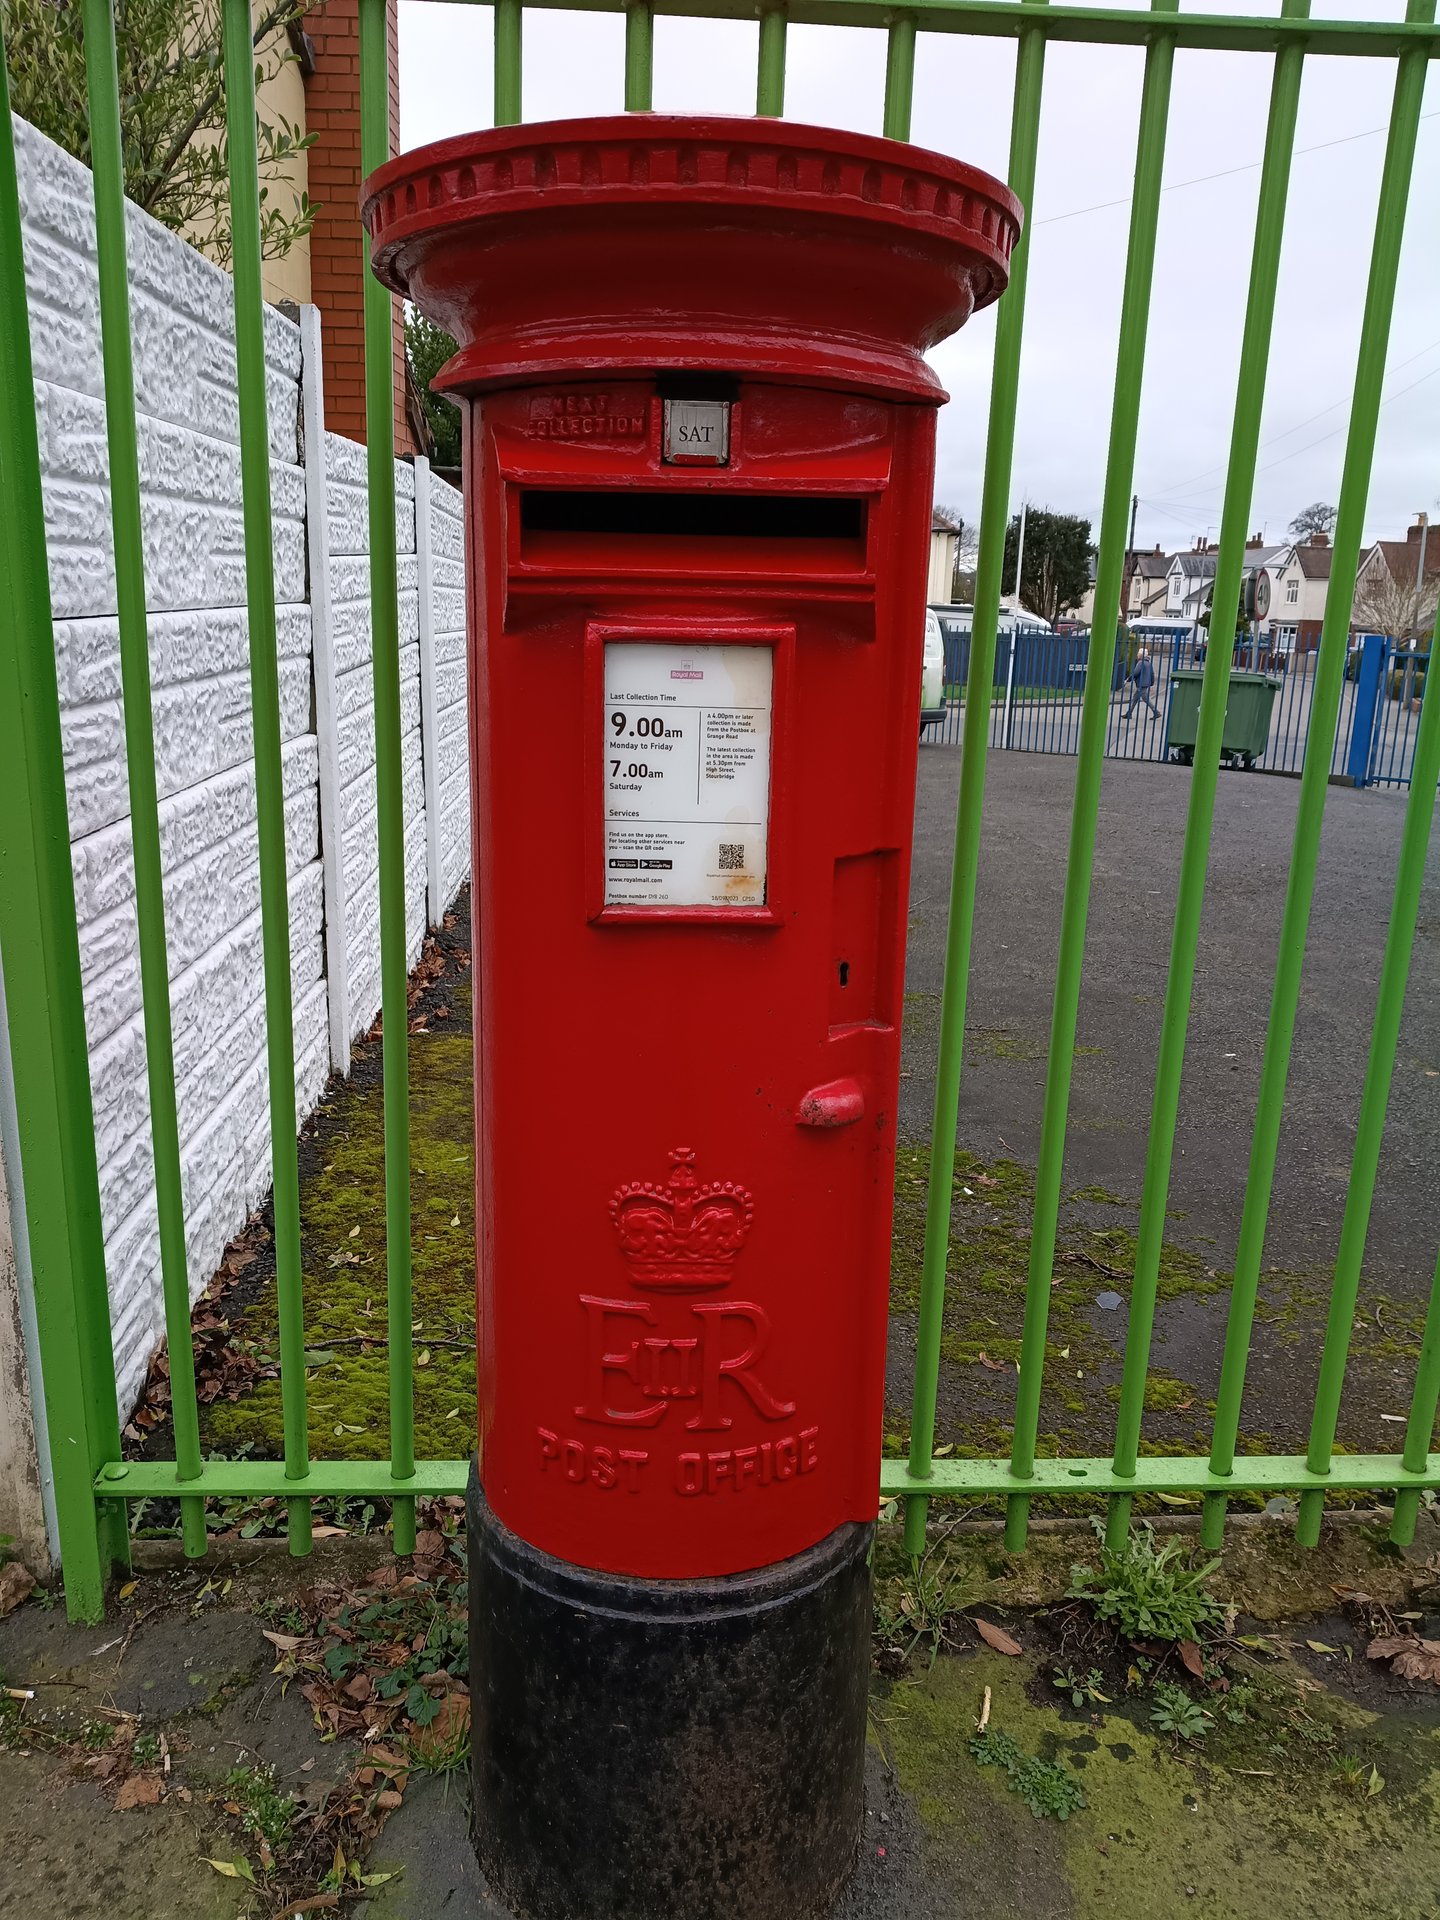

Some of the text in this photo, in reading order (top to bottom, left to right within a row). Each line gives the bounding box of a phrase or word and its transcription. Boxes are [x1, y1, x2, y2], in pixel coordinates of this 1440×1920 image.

[527, 417, 644, 436] COLLECTION
[679, 426, 714, 442] SAT
[1258, 584, 1269, 605] 40
[611, 712, 682, 738] 9.00am
[610, 742, 638, 750] Monday
[650, 743, 673, 751] Friday
[610, 760, 663, 778] 7.00am
[609, 783, 642, 791] Saturday
[536, 1425, 819, 1496] POST OFFICE
